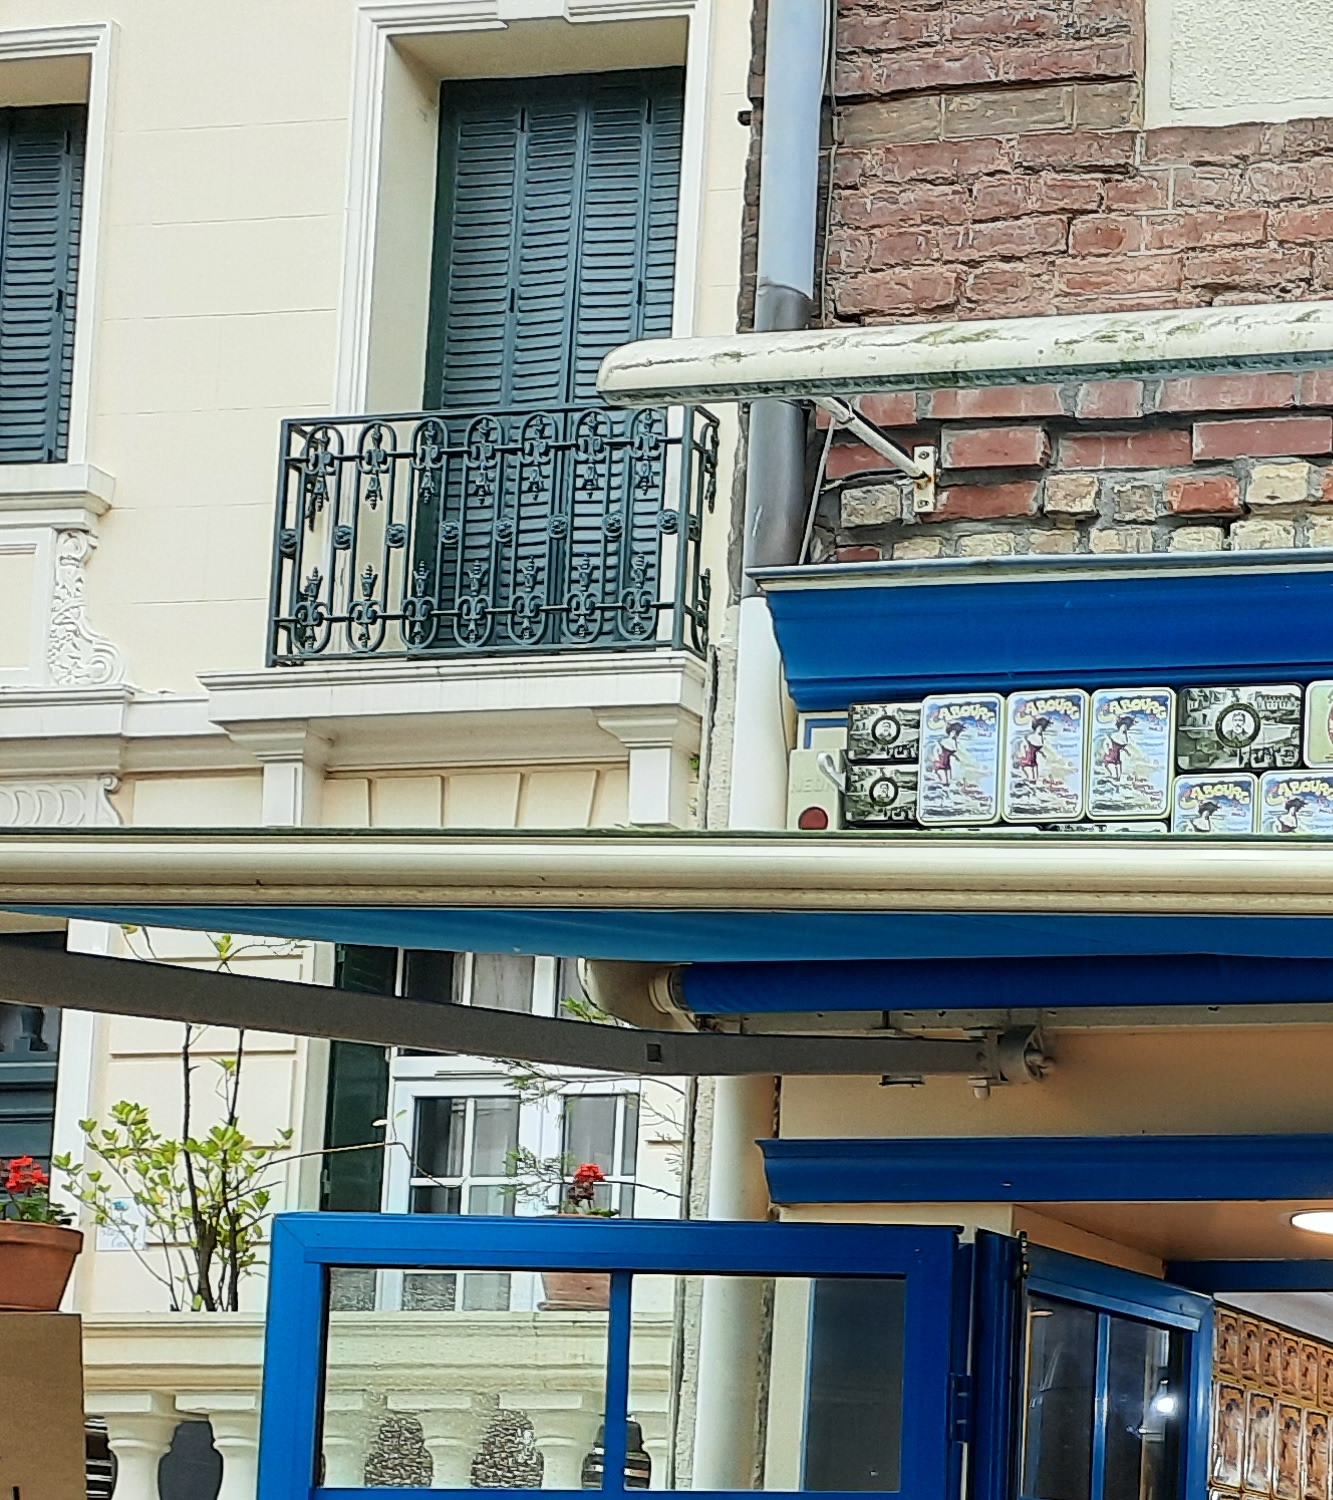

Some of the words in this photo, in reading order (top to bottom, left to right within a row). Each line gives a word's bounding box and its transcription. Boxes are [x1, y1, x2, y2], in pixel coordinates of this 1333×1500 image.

[926, 700, 996, 730] CABOURG
[1014, 698, 1081, 727] CABOURG
[1095, 698, 1167, 726] CABOURG
[1179, 781, 1249, 808] CABOURG
